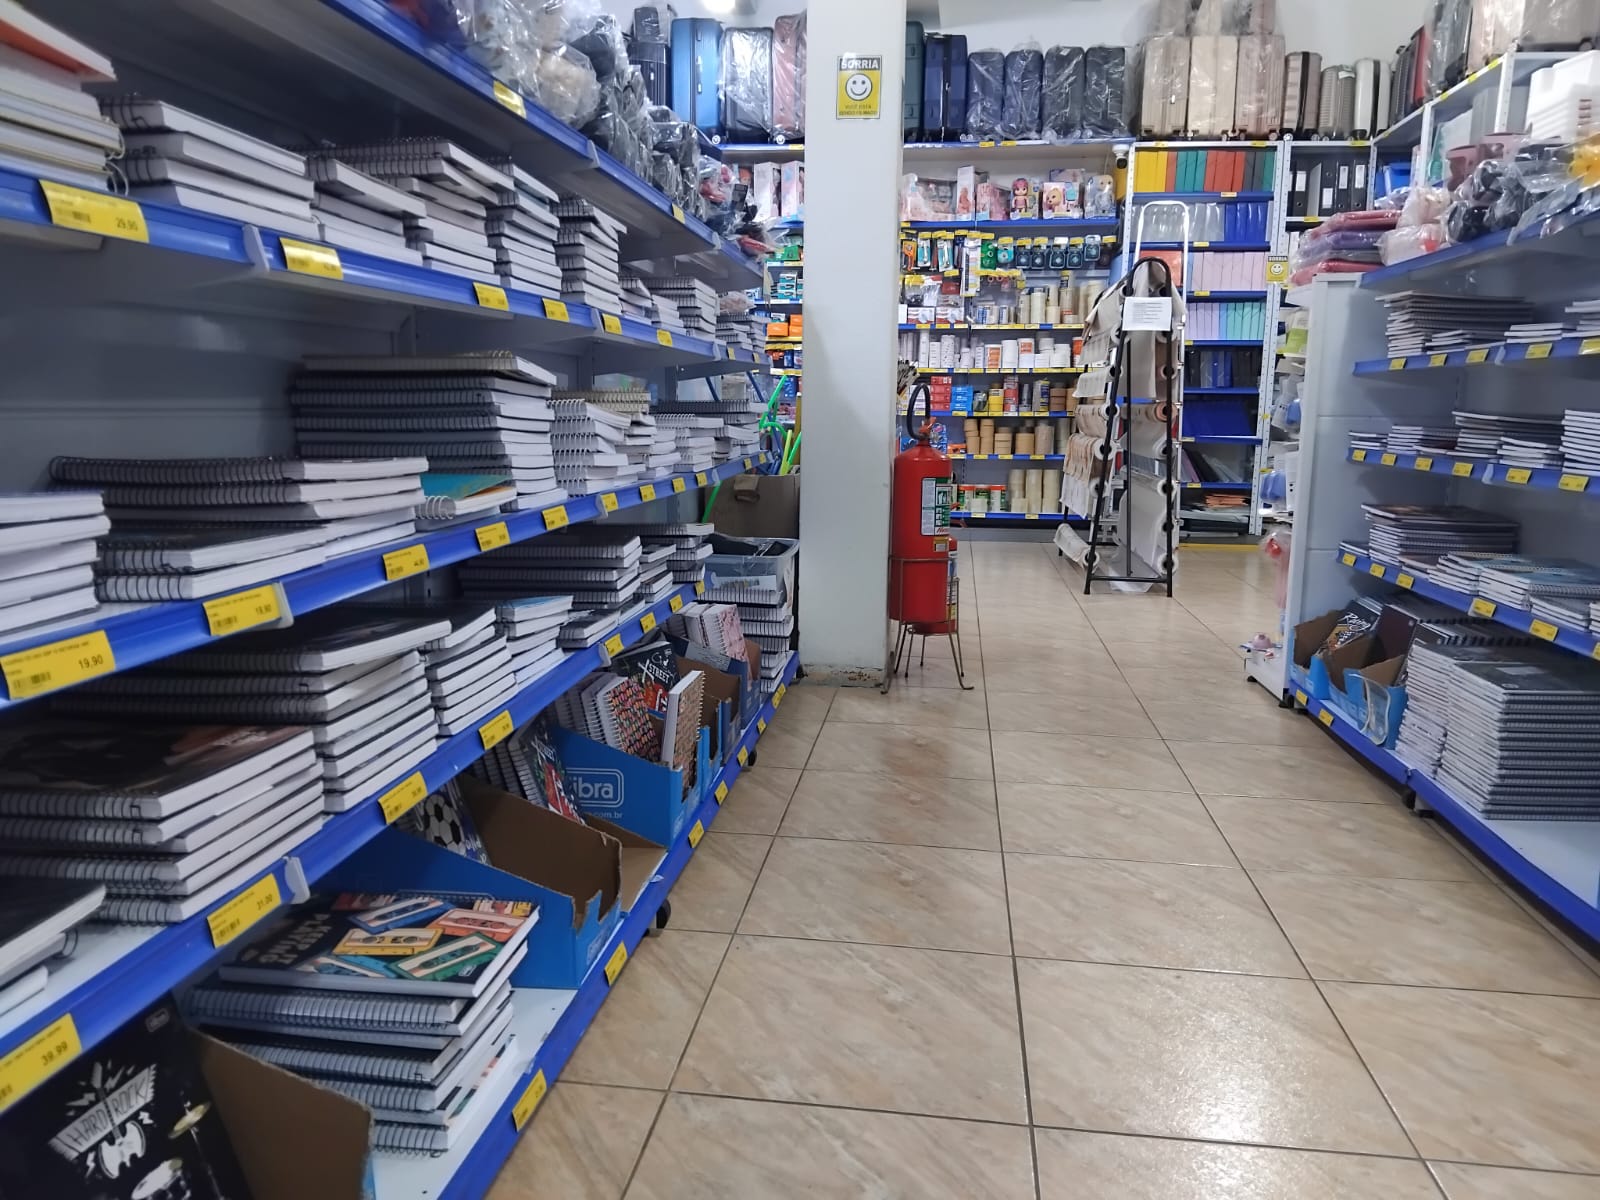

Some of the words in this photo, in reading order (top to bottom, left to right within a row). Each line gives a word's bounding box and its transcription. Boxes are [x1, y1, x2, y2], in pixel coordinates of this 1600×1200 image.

[841, 59, 879, 69] SORRIA
[572, 776, 614, 799] ibra
[67, 1108, 109, 1147] HARD
[111, 1077, 147, 1117] ROCK
